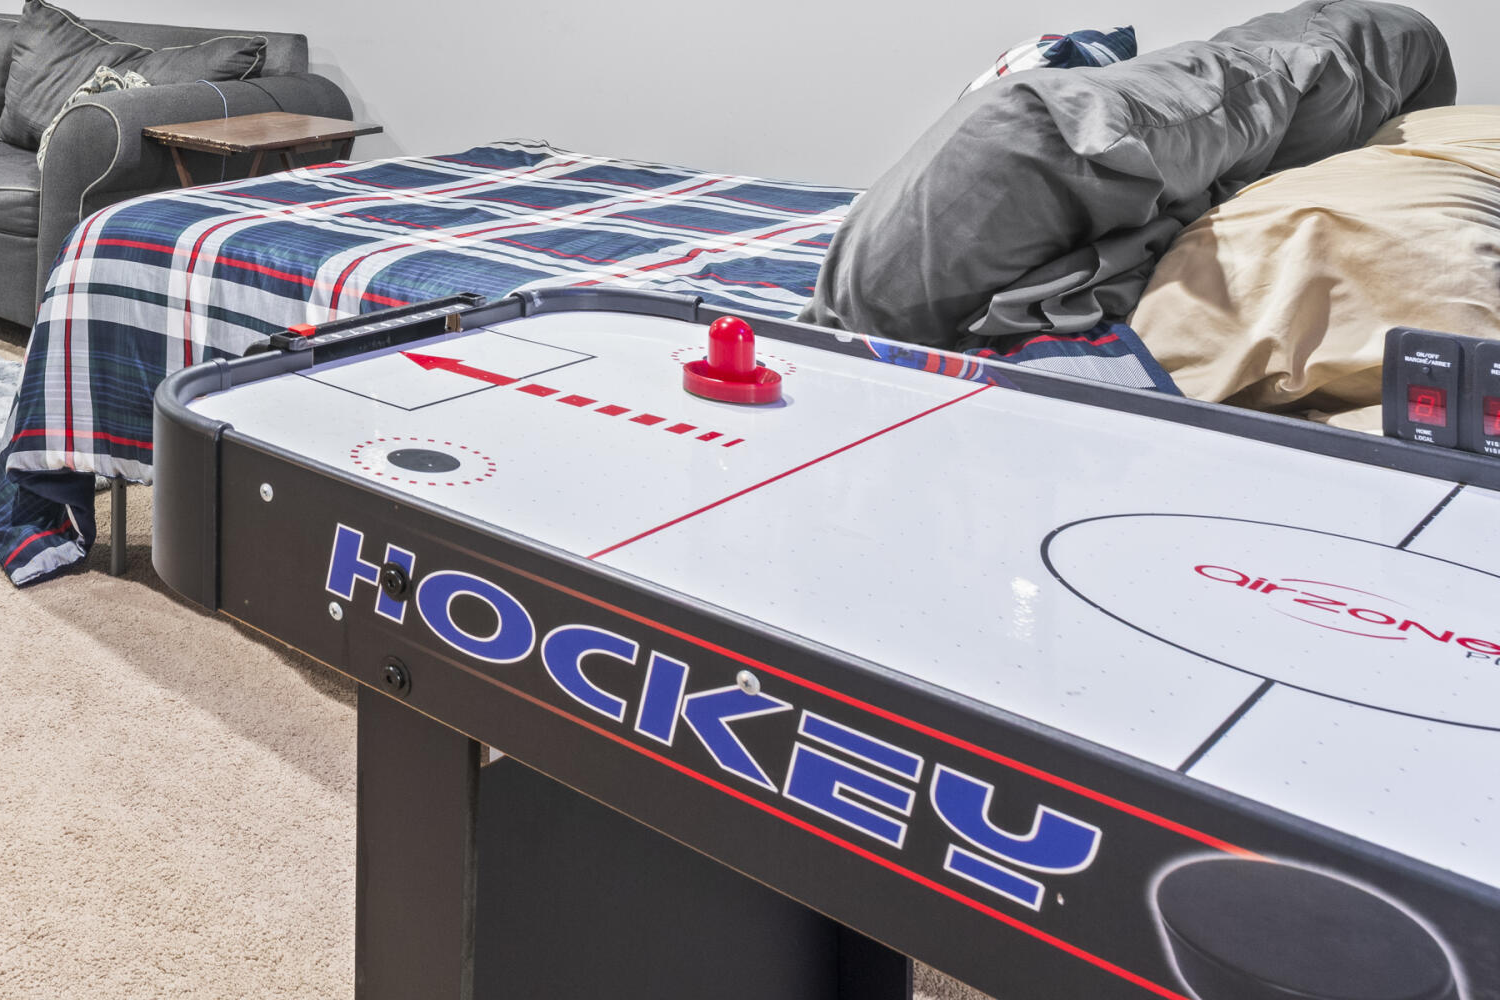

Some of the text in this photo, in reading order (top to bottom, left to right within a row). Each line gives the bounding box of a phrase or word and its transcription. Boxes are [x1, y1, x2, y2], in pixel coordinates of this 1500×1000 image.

[1415, 351, 1440, 360] ON/OFF
[1414, 434, 1435, 443] LOCAL
[325, 523, 1102, 911] HOCKEY
